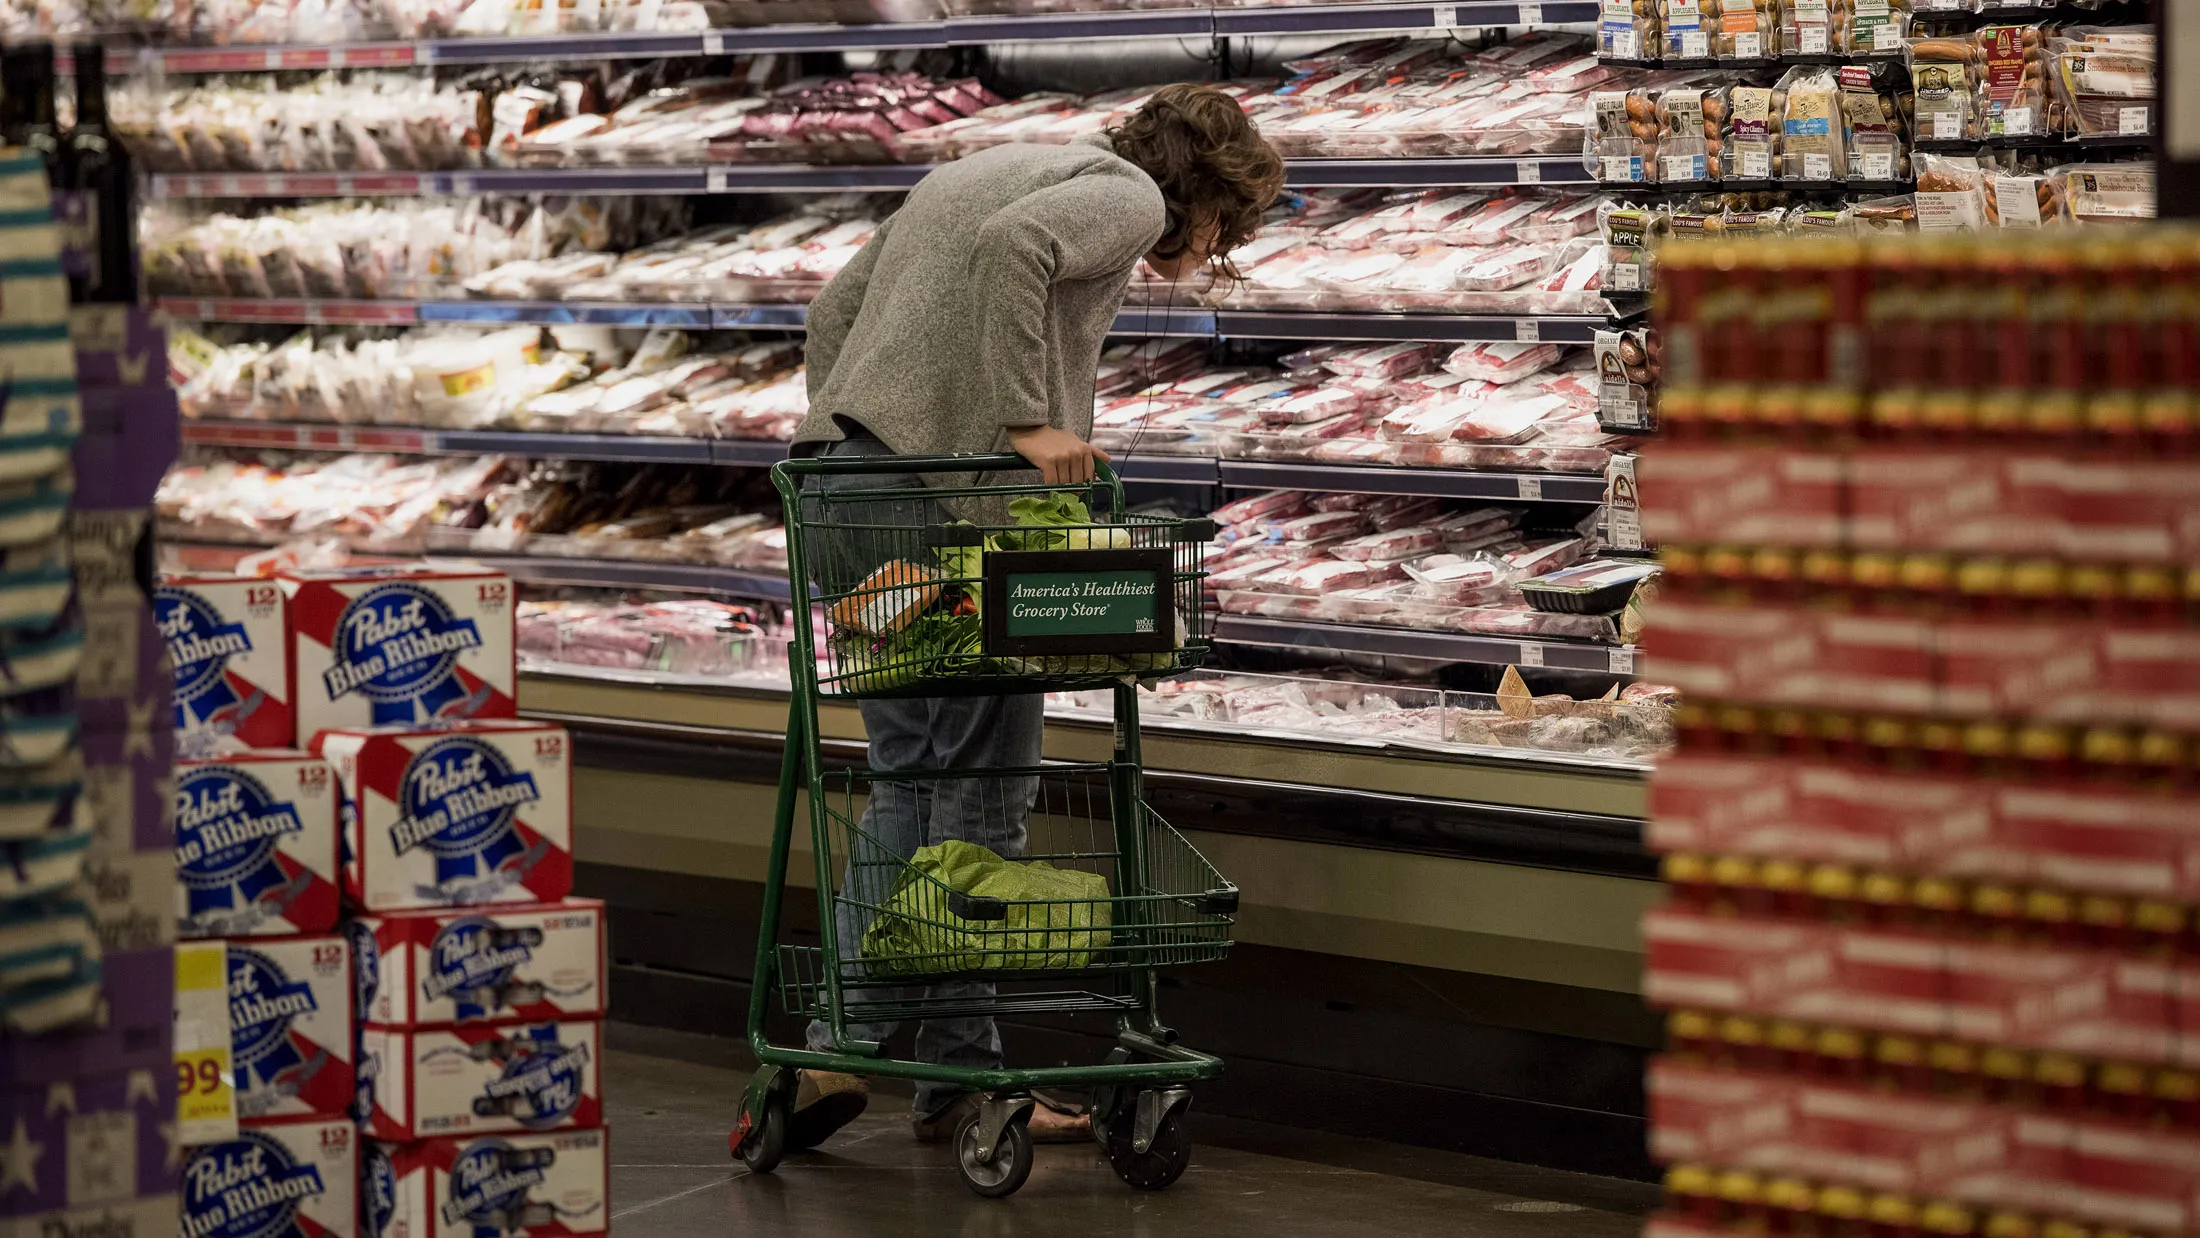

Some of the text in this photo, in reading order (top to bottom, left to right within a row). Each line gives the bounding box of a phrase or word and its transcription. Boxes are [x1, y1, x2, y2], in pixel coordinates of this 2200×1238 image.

[2088, 62, 2126, 72] Smokehouse
[2127, 64, 2146, 73] Bacon
[1668, 102, 1679, 111] MAKE
[1684, 102, 1700, 110] ITALIAN
[2099, 182, 2136, 192] Smokehouse
[1614, 232, 1639, 245] APPLE
[248, 588, 277, 605] 12
[476, 584, 506, 601] 12
[1011, 581, 1155, 598] America's Healthiest
[1013, 603, 1068, 620] Grocery
[346, 598, 426, 652] Pabst
[171, 632, 244, 667] ibbon
[326, 627, 475, 700] Blue Ribbon
[534, 737, 561, 756] 12
[298, 767, 327, 785] 12
[410, 753, 486, 806] Pabst
[394, 782, 532, 850] Blue Ribbon
[198, 811, 296, 854] Ribbon
[314, 945, 341, 965] 12
[232, 992, 310, 1028] ibbon
[319, 1127, 348, 1146] 12
[187, 1146, 266, 1203] Pabst
[183, 1174, 318, 1238] lue Ribbon
